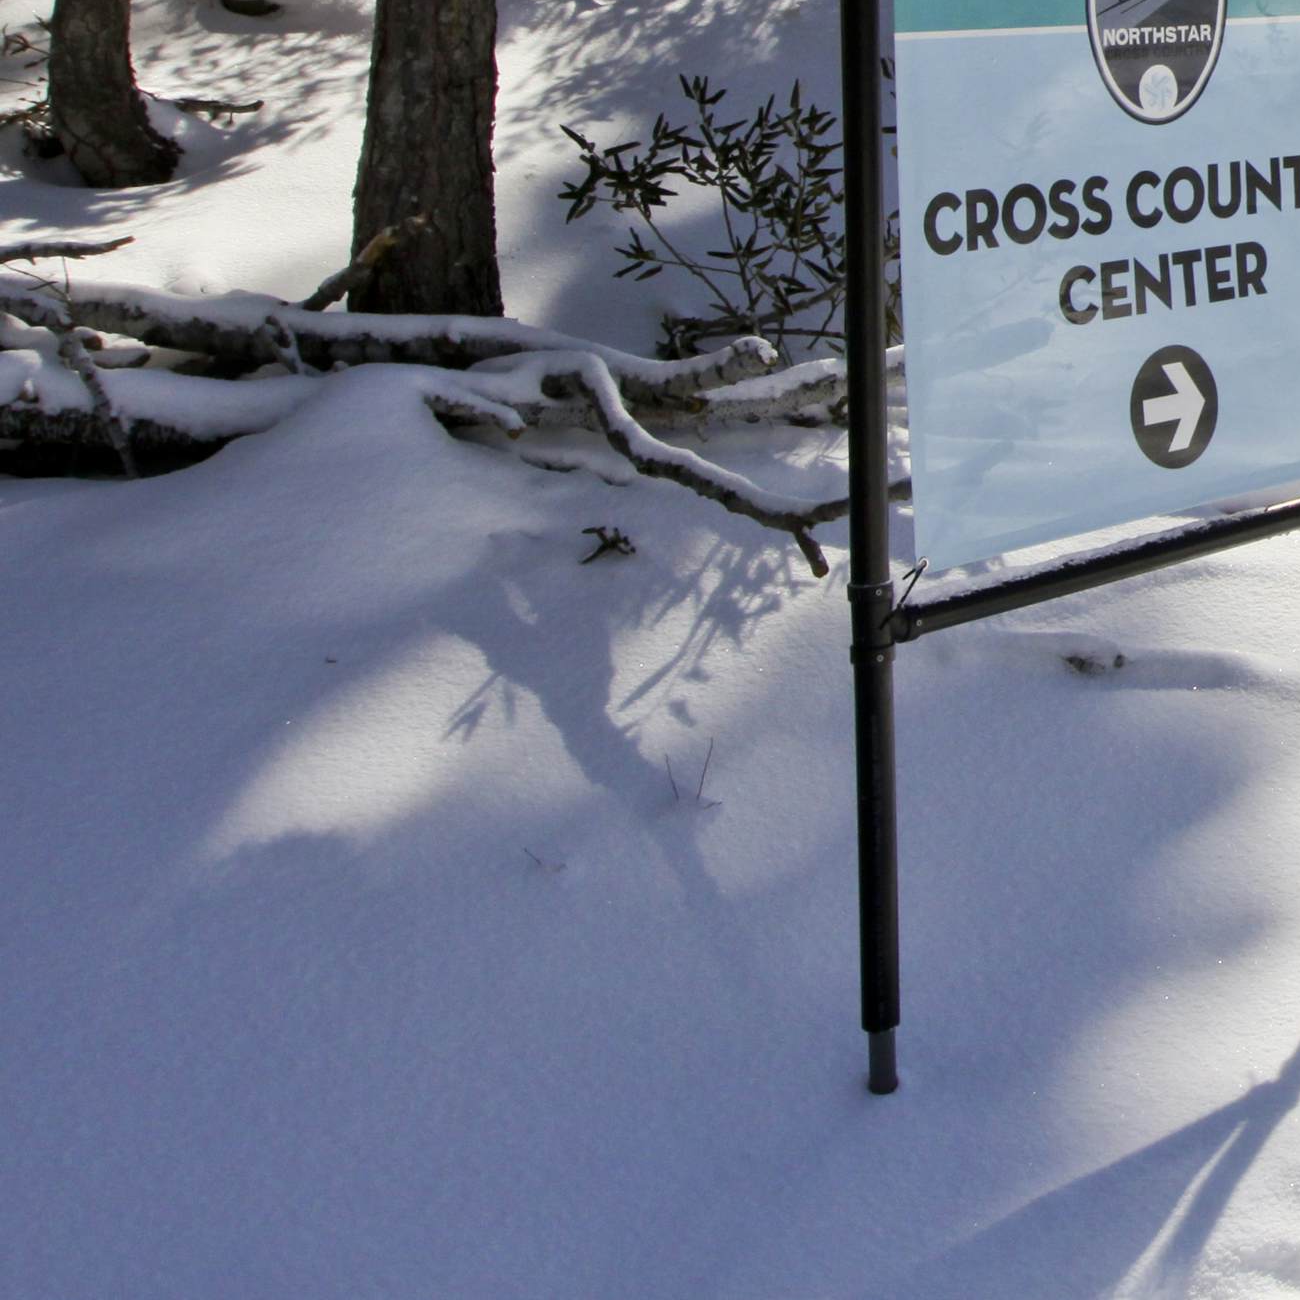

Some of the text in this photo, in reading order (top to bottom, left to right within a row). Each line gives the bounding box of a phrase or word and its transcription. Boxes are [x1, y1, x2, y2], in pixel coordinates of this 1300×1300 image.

[1103, 24, 1212, 46] NORTHSTAR
[922, 175, 1114, 256] CROSS
[1059, 241, 1268, 325] CENTER
